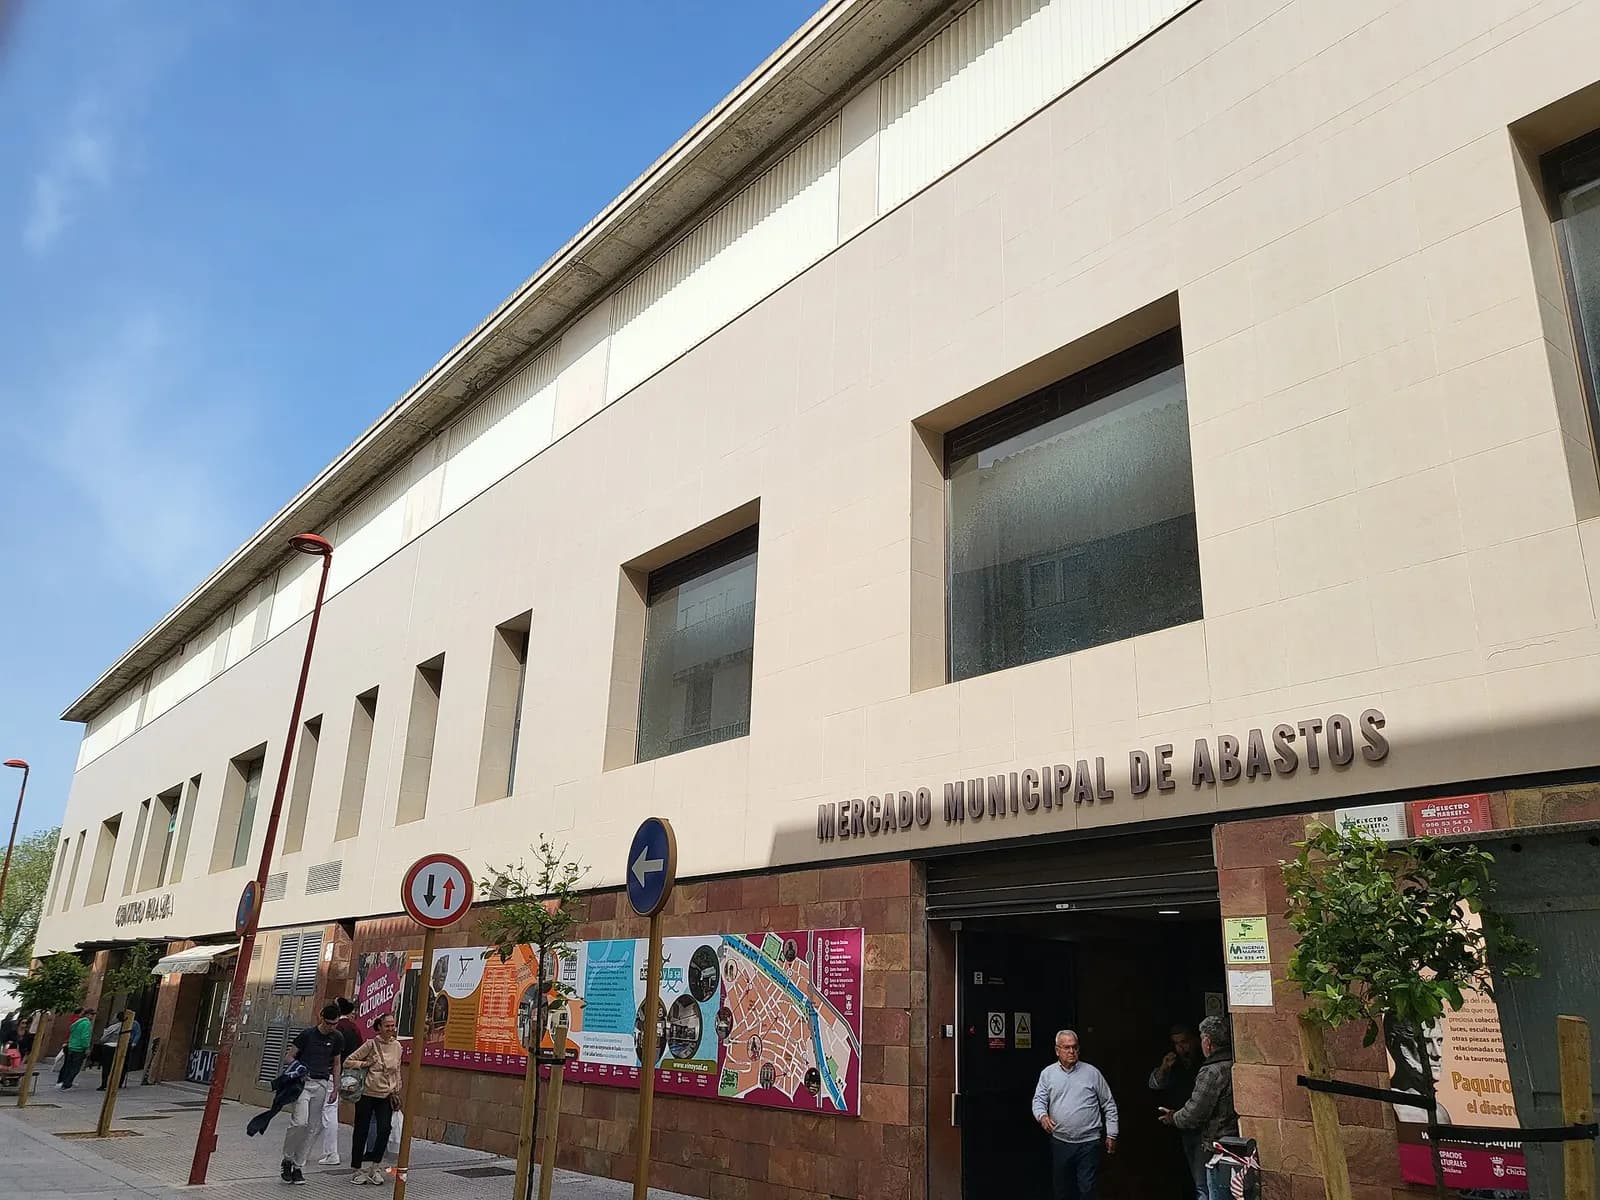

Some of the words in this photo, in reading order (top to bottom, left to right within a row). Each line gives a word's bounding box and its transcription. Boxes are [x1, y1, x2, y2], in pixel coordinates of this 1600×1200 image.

[817, 787, 931, 839] MERCADO
[944, 756, 1114, 821] MUNICIPAL
[1129, 744, 1175, 794] DE
[1192, 709, 1389, 785] ABASTOS
[1435, 803, 1469, 811] ELECTRO
[1426, 825, 1471, 835] FUEGO
[366, 974, 388, 997] ESPACIOS
[360, 984, 394, 1017] CULTURALES
[1453, 1045, 1494, 1053] relacionadas
[1451, 1071, 1513, 1097] Paquiro
[1466, 1099, 1478, 1113] el
[1480, 1100, 1517, 1116] diestr
[1439, 1150, 1462, 1161] SPACIOS
[1440, 1159, 1467, 1168] LTURALES
